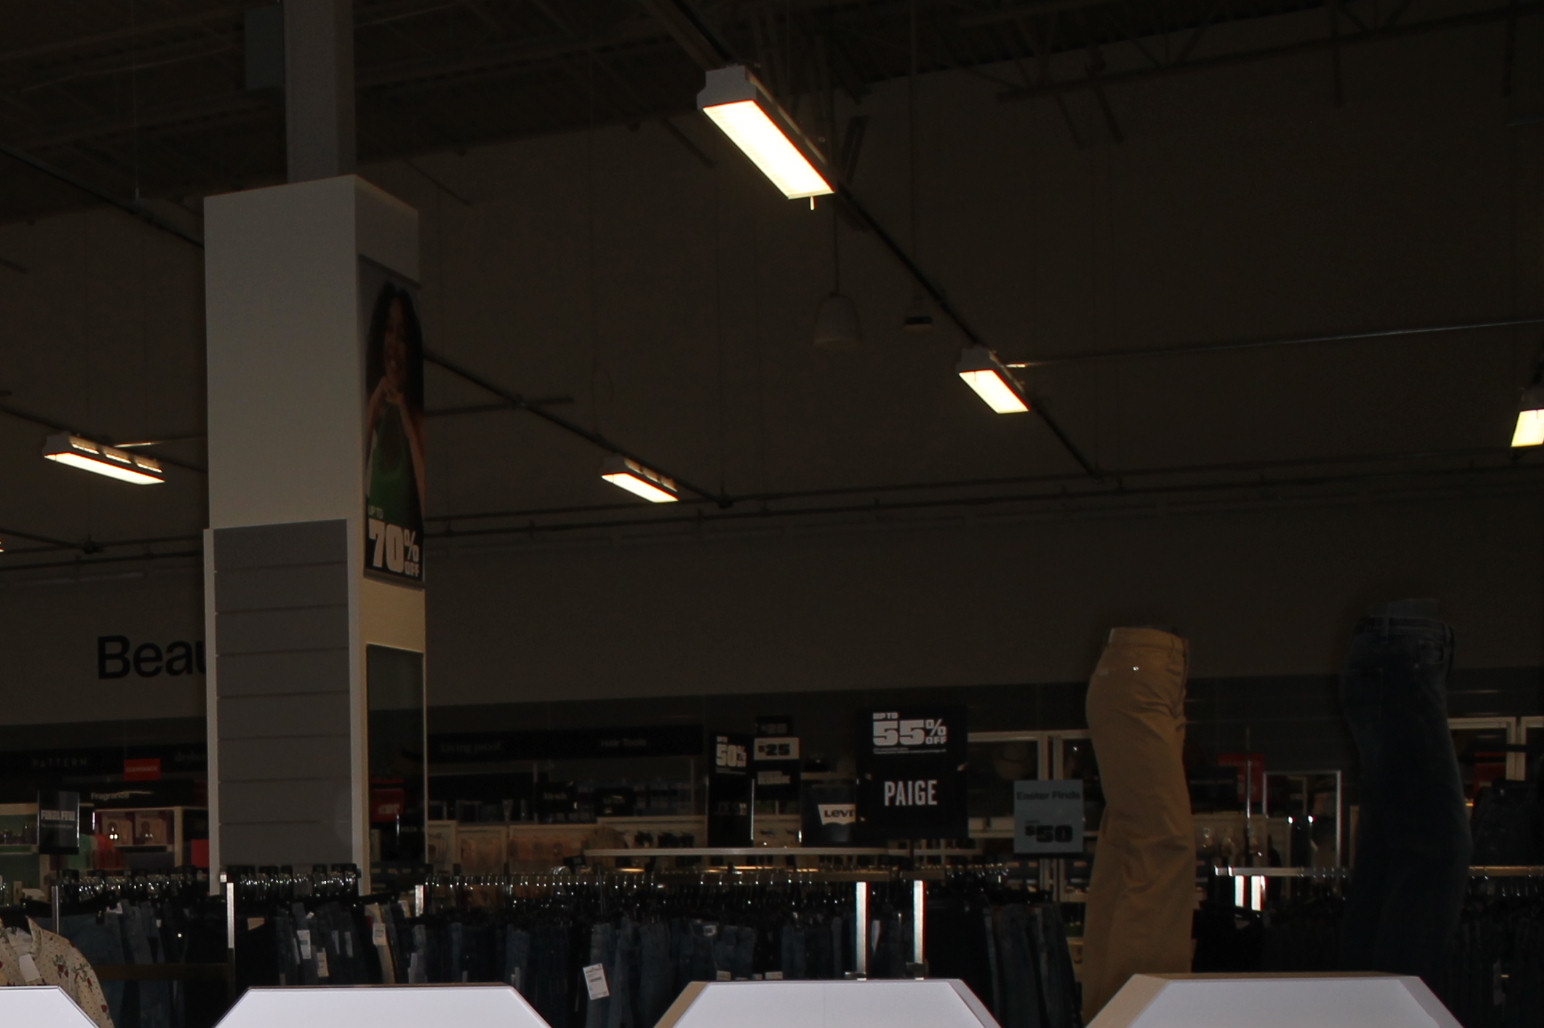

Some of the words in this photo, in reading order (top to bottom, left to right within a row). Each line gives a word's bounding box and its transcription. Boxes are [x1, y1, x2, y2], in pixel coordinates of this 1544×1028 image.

[368, 518, 420, 573] 70%
[405, 561, 419, 577] OFF
[872, 719, 947, 746] 55%
[925, 737, 947, 745] OFF
[884, 779, 938, 807] PAIGE
[1025, 825, 1073, 842] $50
